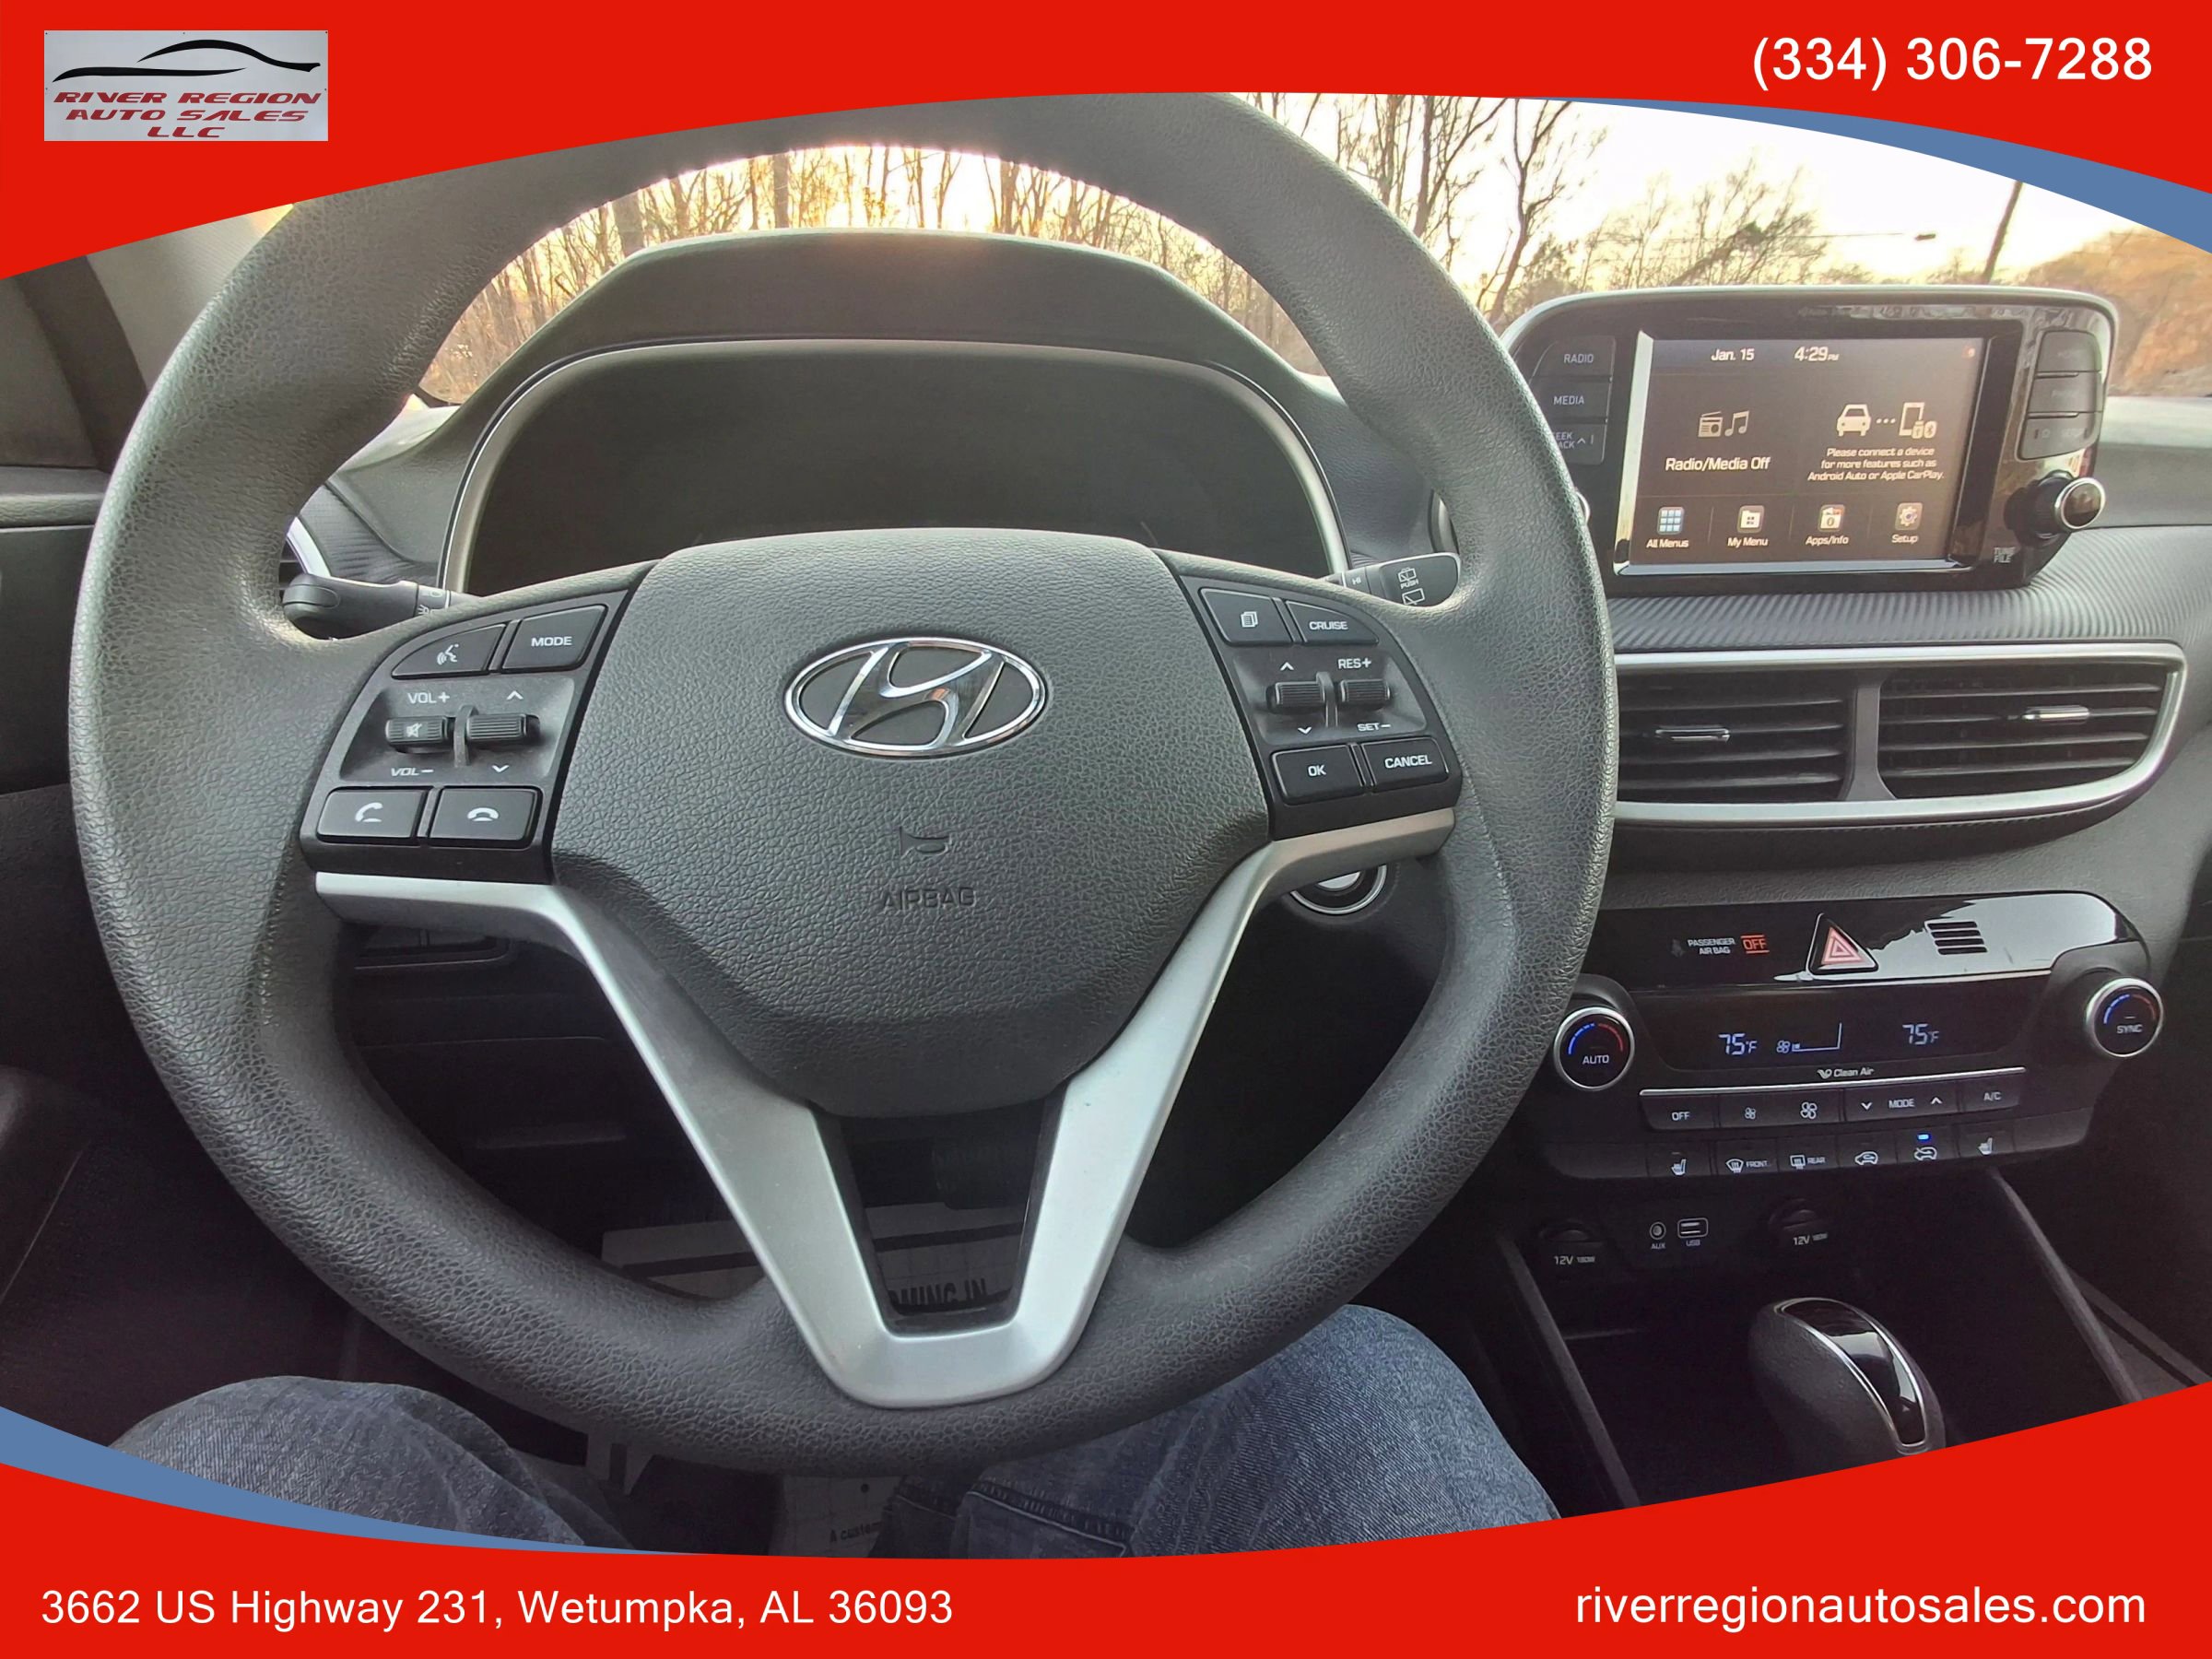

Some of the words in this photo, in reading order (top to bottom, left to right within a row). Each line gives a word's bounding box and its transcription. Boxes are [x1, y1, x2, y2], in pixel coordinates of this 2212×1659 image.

[1563, 354, 1594, 363] RADIO
[1711, 349, 1735, 360] Jan.
[1740, 348, 1755, 360] 15
[1553, 395, 1584, 406] MEDIA
[1552, 431, 1572, 441] EEK
[1827, 448, 1856, 457] Please
[1858, 448, 1896, 456] connect
[1905, 447, 1935, 456] device
[1665, 457, 1748, 471] Radio/Media
[1751, 457, 1771, 470] Off
[1821, 460, 1835, 469] for
[1863, 459, 1901, 468] features
[1902, 459, 1924, 467] such
[1807, 472, 1843, 481] Android
[1844, 471, 1866, 480] Auto
[1880, 471, 1906, 481] Apple
[1646, 538, 1658, 548] All
[1659, 538, 1689, 548] Menus
[1727, 537, 1742, 548] My
[1743, 537, 1768, 547] Menu
[1806, 535, 1849, 546] Apps/Info
[1891, 534, 1919, 545] Setup
[1309, 620, 1348, 631] CRUISE
[531, 636, 572, 647] MODE
[1384, 755, 1432, 770] CANCEL
[1308, 764, 1326, 777] OK
[882, 887, 976, 912] AIRBAG
[1688, 937, 1735, 947] PASSENGER
[1743, 939, 1767, 950] OFF
[2116, 1024, 2143, 1034] SYNC
[1582, 1054, 1610, 1065] AUTO
[1833, 1068, 1858, 1077] Clean
[1860, 1066, 1875, 1076] Air
[1983, 1091, 2003, 1101] A/C
[1888, 1099, 1915, 1109] MODE
[1672, 1112, 1689, 1122] OFF
[1746, 1160, 1768, 1169] FRONT
[1807, 1156, 1826, 1164] REAR
[1686, 1239, 1700, 1247] USB
[1793, 1235, 1811, 1246] 12V
[1554, 1255, 1574, 1266] 12V
